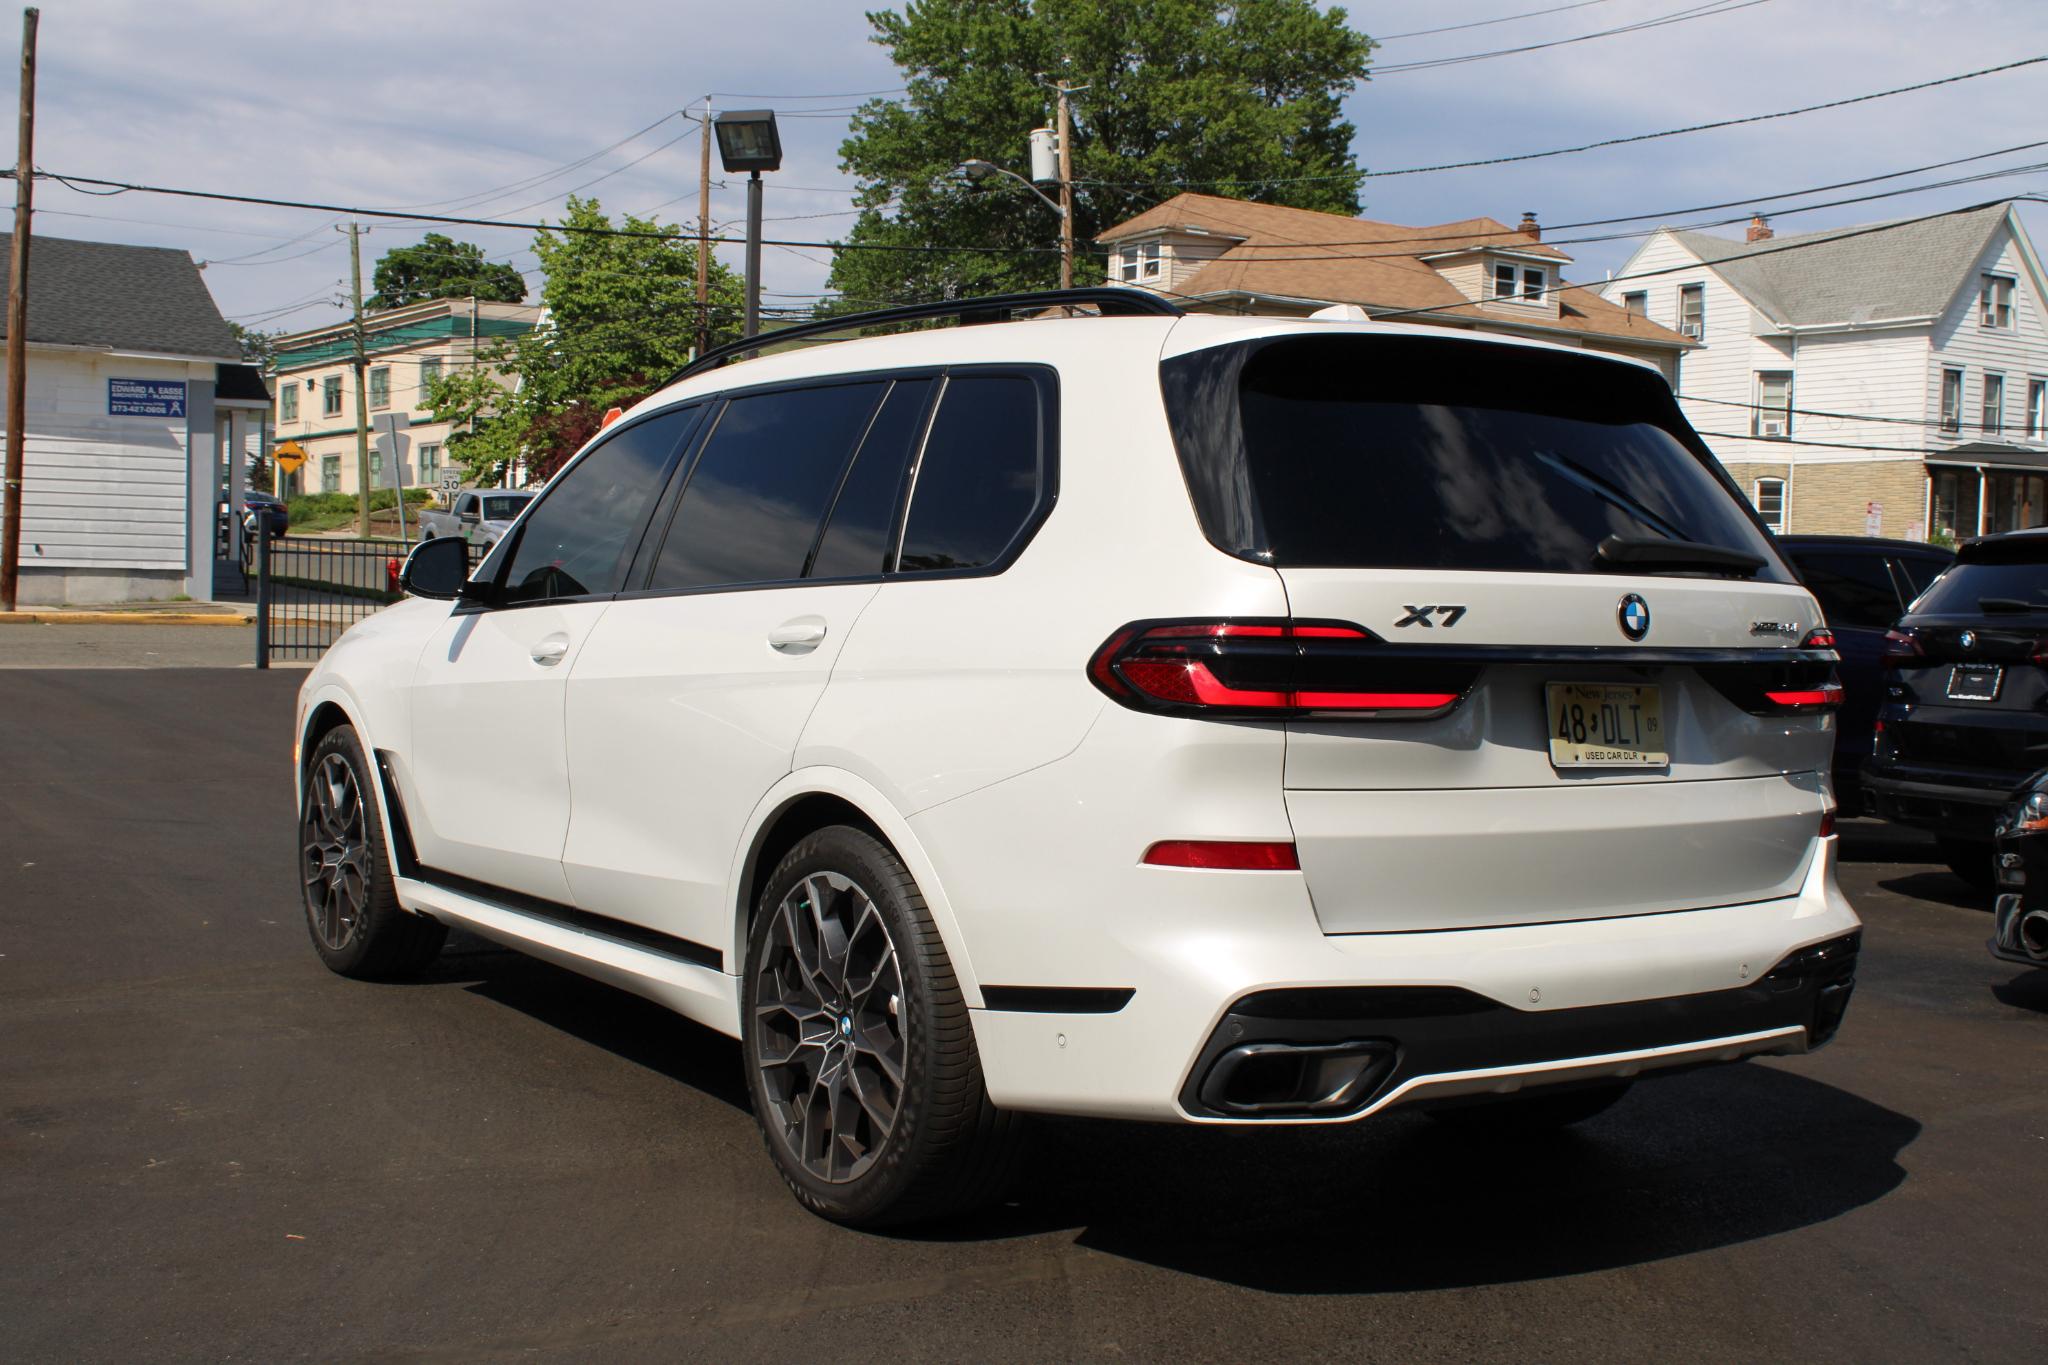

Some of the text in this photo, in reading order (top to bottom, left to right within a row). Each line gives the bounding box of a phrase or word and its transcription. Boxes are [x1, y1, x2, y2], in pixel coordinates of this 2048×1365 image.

[112, 385, 184, 395] EDWARD A. EASSE
[443, 480, 459, 490] 30
[1393, 605, 1467, 628] X7
[1575, 685, 1600, 699] New
[1559, 703, 1641, 745] 48 DLT
[1646, 716, 1658, 732] 09
[1585, 751, 1638, 760] USED CAR DLR
